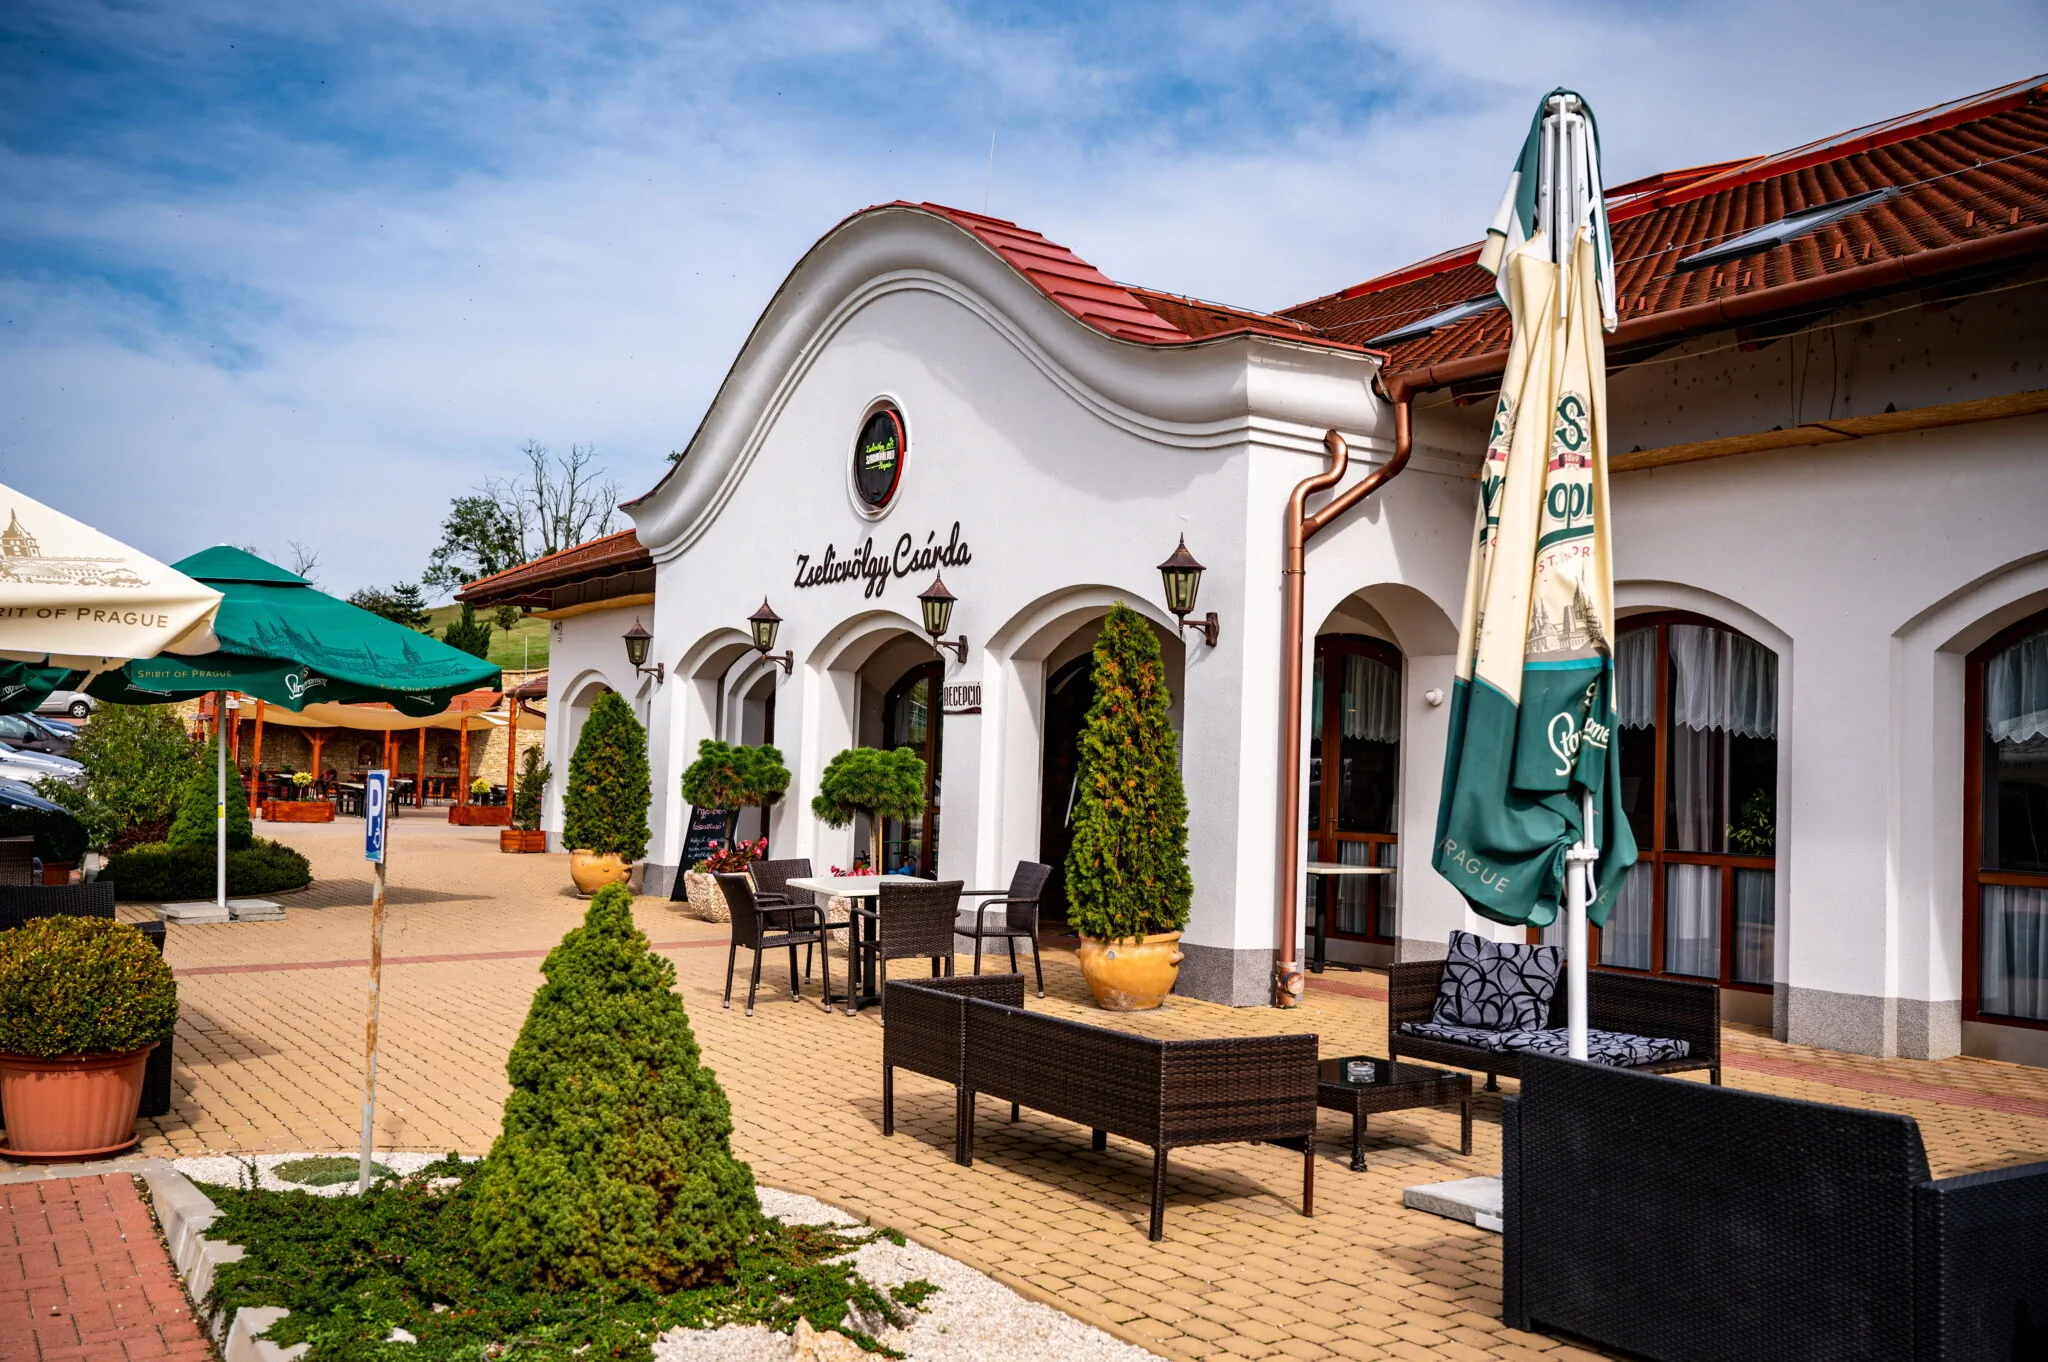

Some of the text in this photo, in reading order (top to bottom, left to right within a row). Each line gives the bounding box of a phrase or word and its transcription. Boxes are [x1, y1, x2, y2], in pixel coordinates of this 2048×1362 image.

[794, 521, 972, 599] Zselicvölgy Csárda
[36, 608, 67, 620] OF
[77, 607, 169, 628] PRAGUE
[138, 670, 170, 678] SPIRIT
[191, 669, 233, 678] PRAGUE
[943, 682, 982, 707] RECEPCIÓ
[368, 779, 382, 836] P
